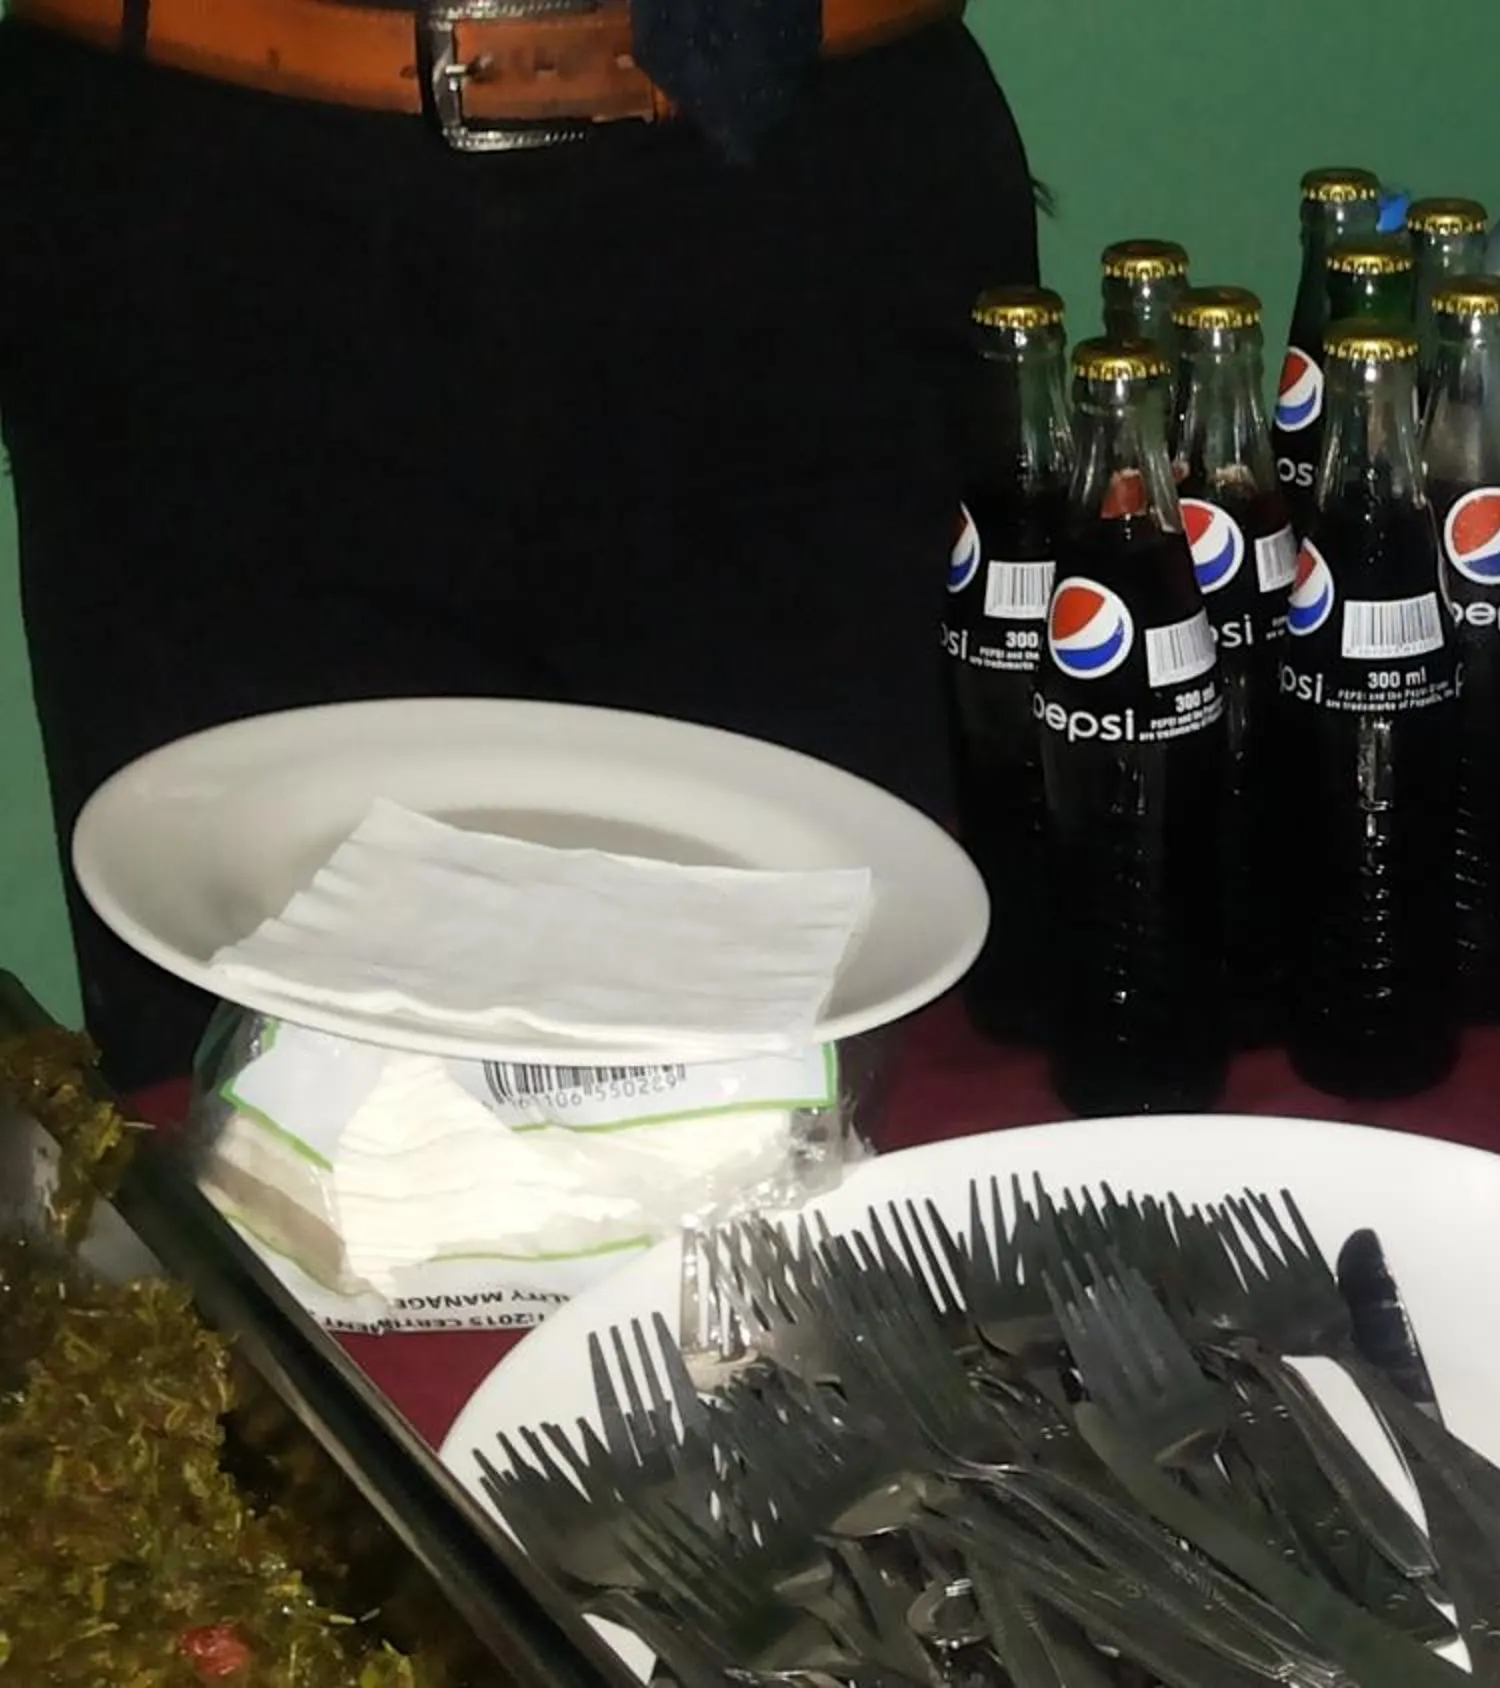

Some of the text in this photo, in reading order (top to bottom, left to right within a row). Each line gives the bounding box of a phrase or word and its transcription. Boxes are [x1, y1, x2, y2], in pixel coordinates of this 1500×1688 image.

[1005, 631, 1039, 649] 300
[1367, 665, 1427, 689] 300 ml
[1174, 689, 1201, 713] 300
[1033, 691, 1135, 742] pepsi
